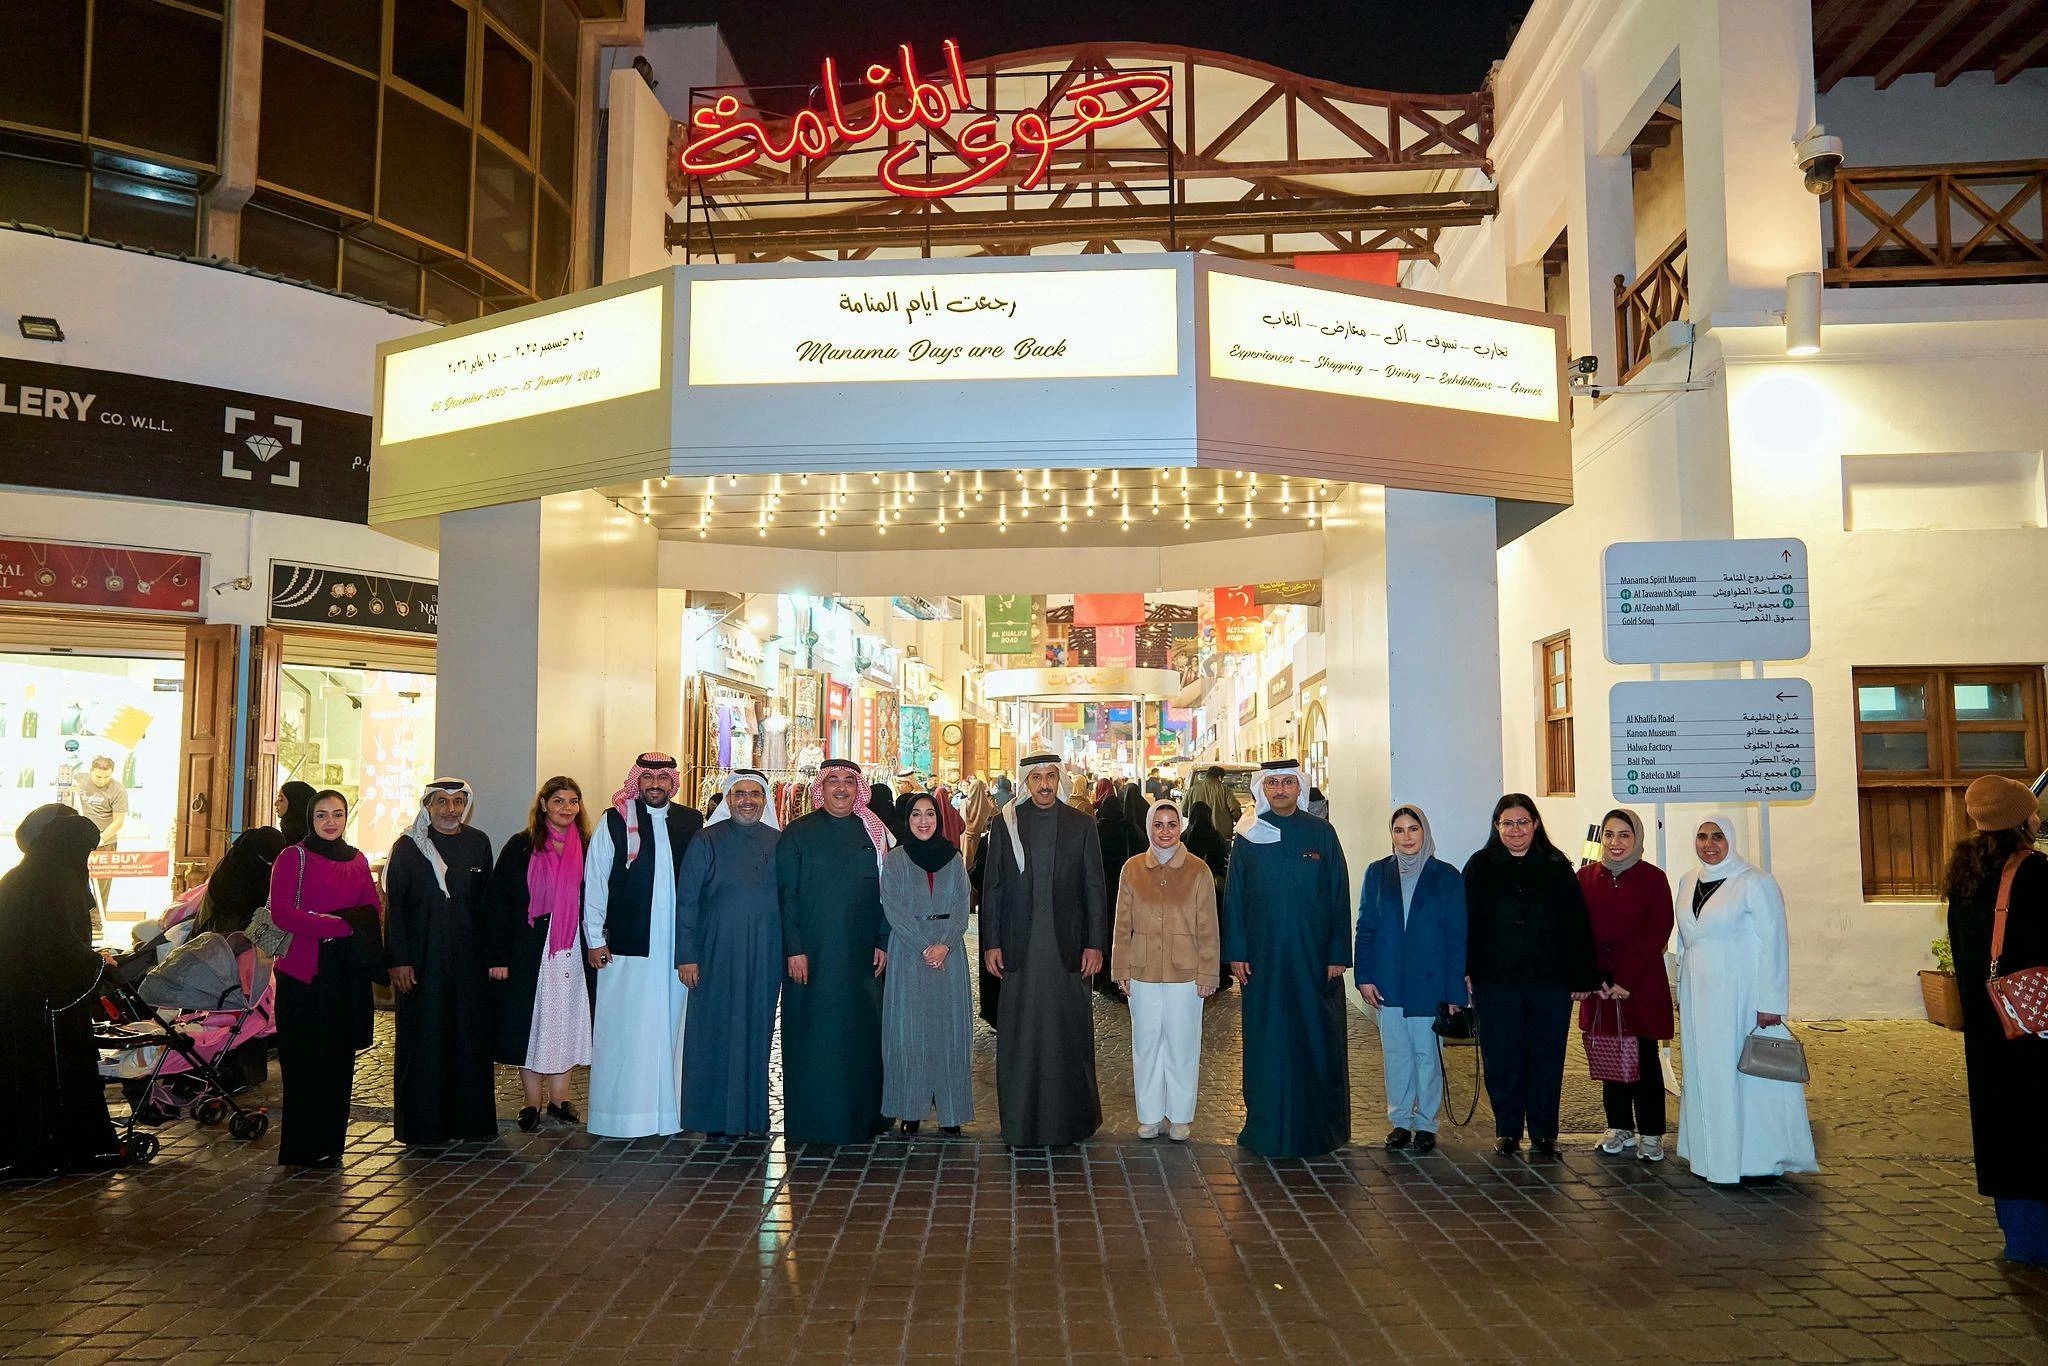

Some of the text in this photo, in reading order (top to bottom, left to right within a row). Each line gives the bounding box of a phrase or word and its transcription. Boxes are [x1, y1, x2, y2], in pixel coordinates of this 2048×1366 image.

[680, 37, 972, 176] المنامة
[839, 285, 1017, 325] رجعت أيام المنامة
[796, 337, 1067, 365] Manama Days are Back
[1229, 344, 1296, 364] Experiences
[1314, 355, 1364, 376] Shopping
[1384, 364, 1421, 384] Dining
[1438, 372, 1494, 391] Exhibitions
[1510, 381, 1544, 396] Games
[444, 394, 483, 411] December
[486, 385, 508, 399] 2025
[523, 380, 532, 391] 15
[535, 372, 573, 391] January
[577, 367, 601, 382] 2026
[100, 412, 126, 426] CO.
[130, 415, 173, 432] W.L.L.
[1620, 575, 1697, 585] Manama Spirit Museum
[1723, 572, 1792, 583] متحف روح المنامة
[1634, 589, 1697, 599] Al Tawawish Square
[1712, 586, 1780, 598] ساحة الطواويش
[1634, 603, 1680, 612] Al Zeinah Mall
[1733, 601, 1780, 612] مجمع الزينة
[1638, 618, 1655, 627] Souq
[1739, 613, 1794, 624] سوق الذهب
[1226, 634, 1244, 642] ROAD
[1626, 714, 1675, 723] Al Khalifa Road
[1743, 712, 1799, 724] شارع الخليفة
[1626, 729, 1677, 737] Kanoo Museum
[1746, 727, 1799, 738] متحف كانو
[1627, 743, 1672, 753] Halwa Factory
[1743, 741, 1800, 752] مصنع الحلوى
[1627, 757, 1656, 765] Ball Pool
[1641, 771, 1681, 779] Batelco Mall
[1740, 768, 1788, 781] مجمع بتلكو
[1641, 785, 1681, 793] Yateem Mall
[1744, 783, 1788, 795] مجمع يتيم
[111, 854, 141, 864] BUY
